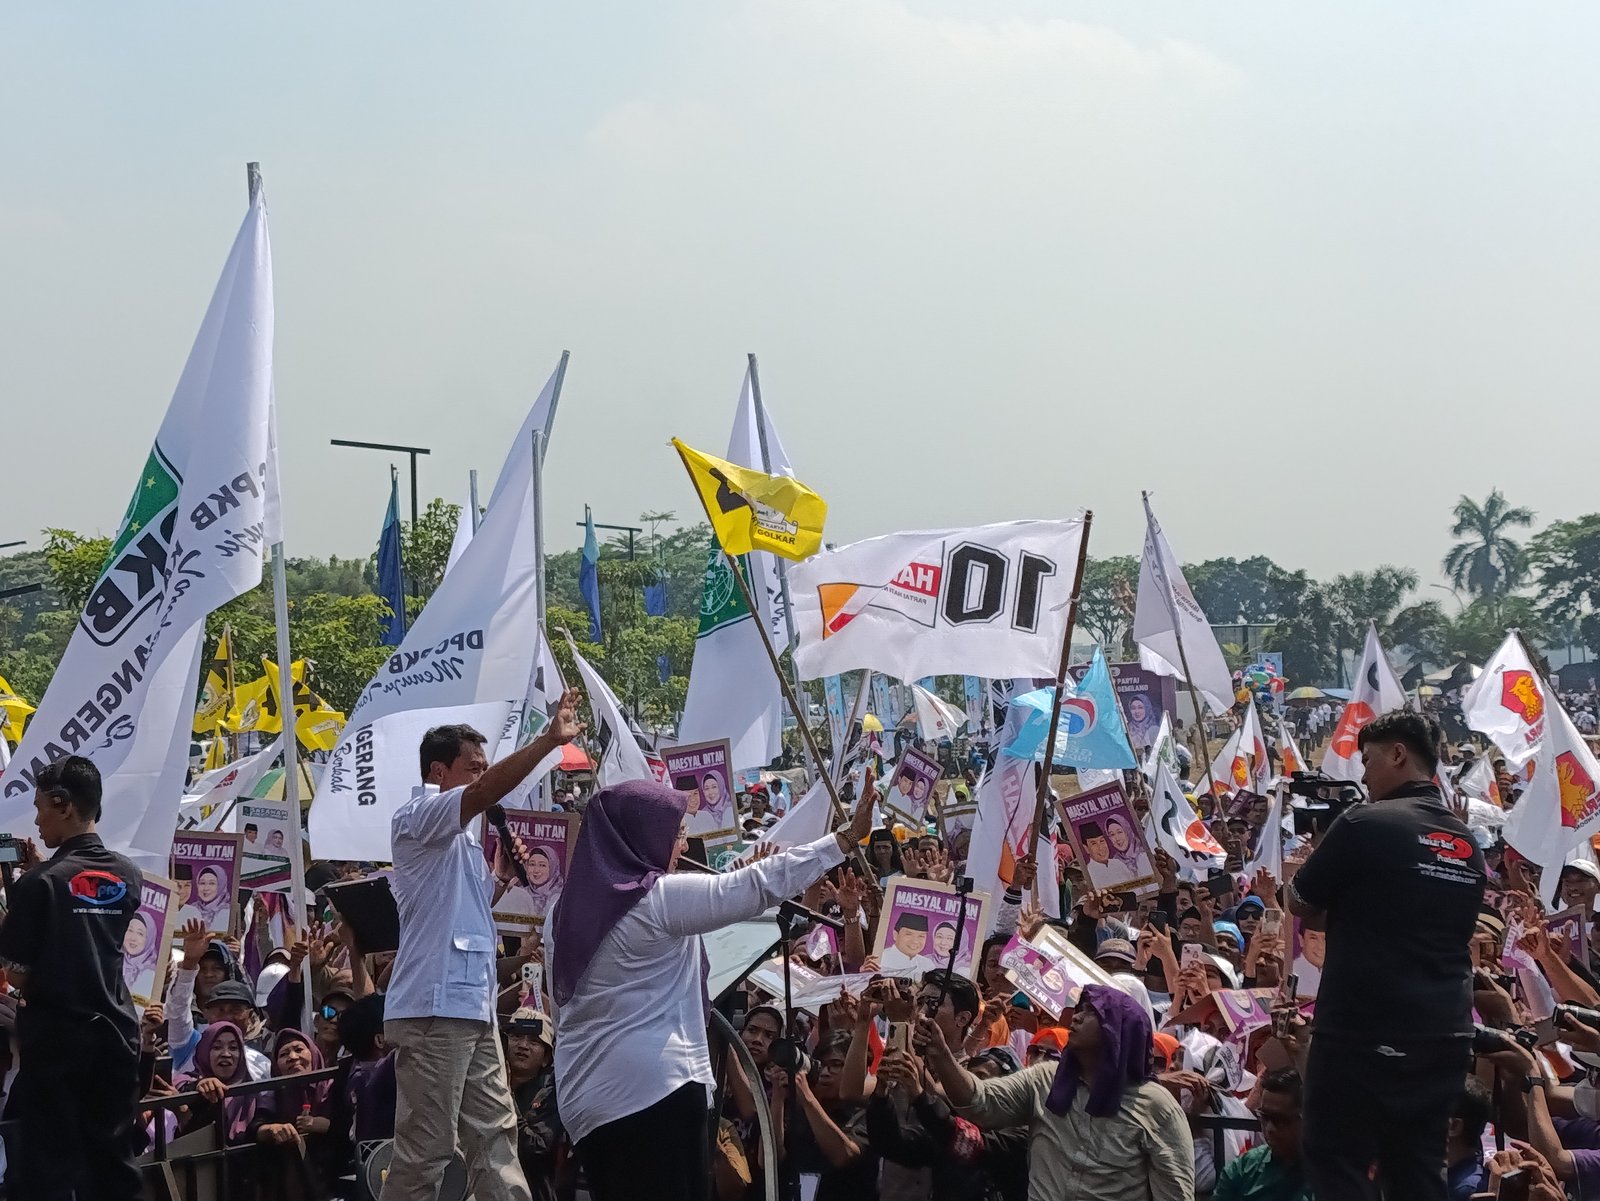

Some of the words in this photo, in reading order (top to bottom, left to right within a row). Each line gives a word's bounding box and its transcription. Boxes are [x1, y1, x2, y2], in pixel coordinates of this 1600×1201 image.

[757, 529, 796, 545] GOLKAR
[669, 755, 701, 770] MAESYAL
[702, 750, 724, 765] INTAN
[1066, 799, 1100, 819] MAESYAL
[1098, 791, 1123, 809] INTAN
[534, 824, 565, 839] INTAN
[205, 845, 234, 858] INTAN
[896, 890, 941, 910] MAESYAL
